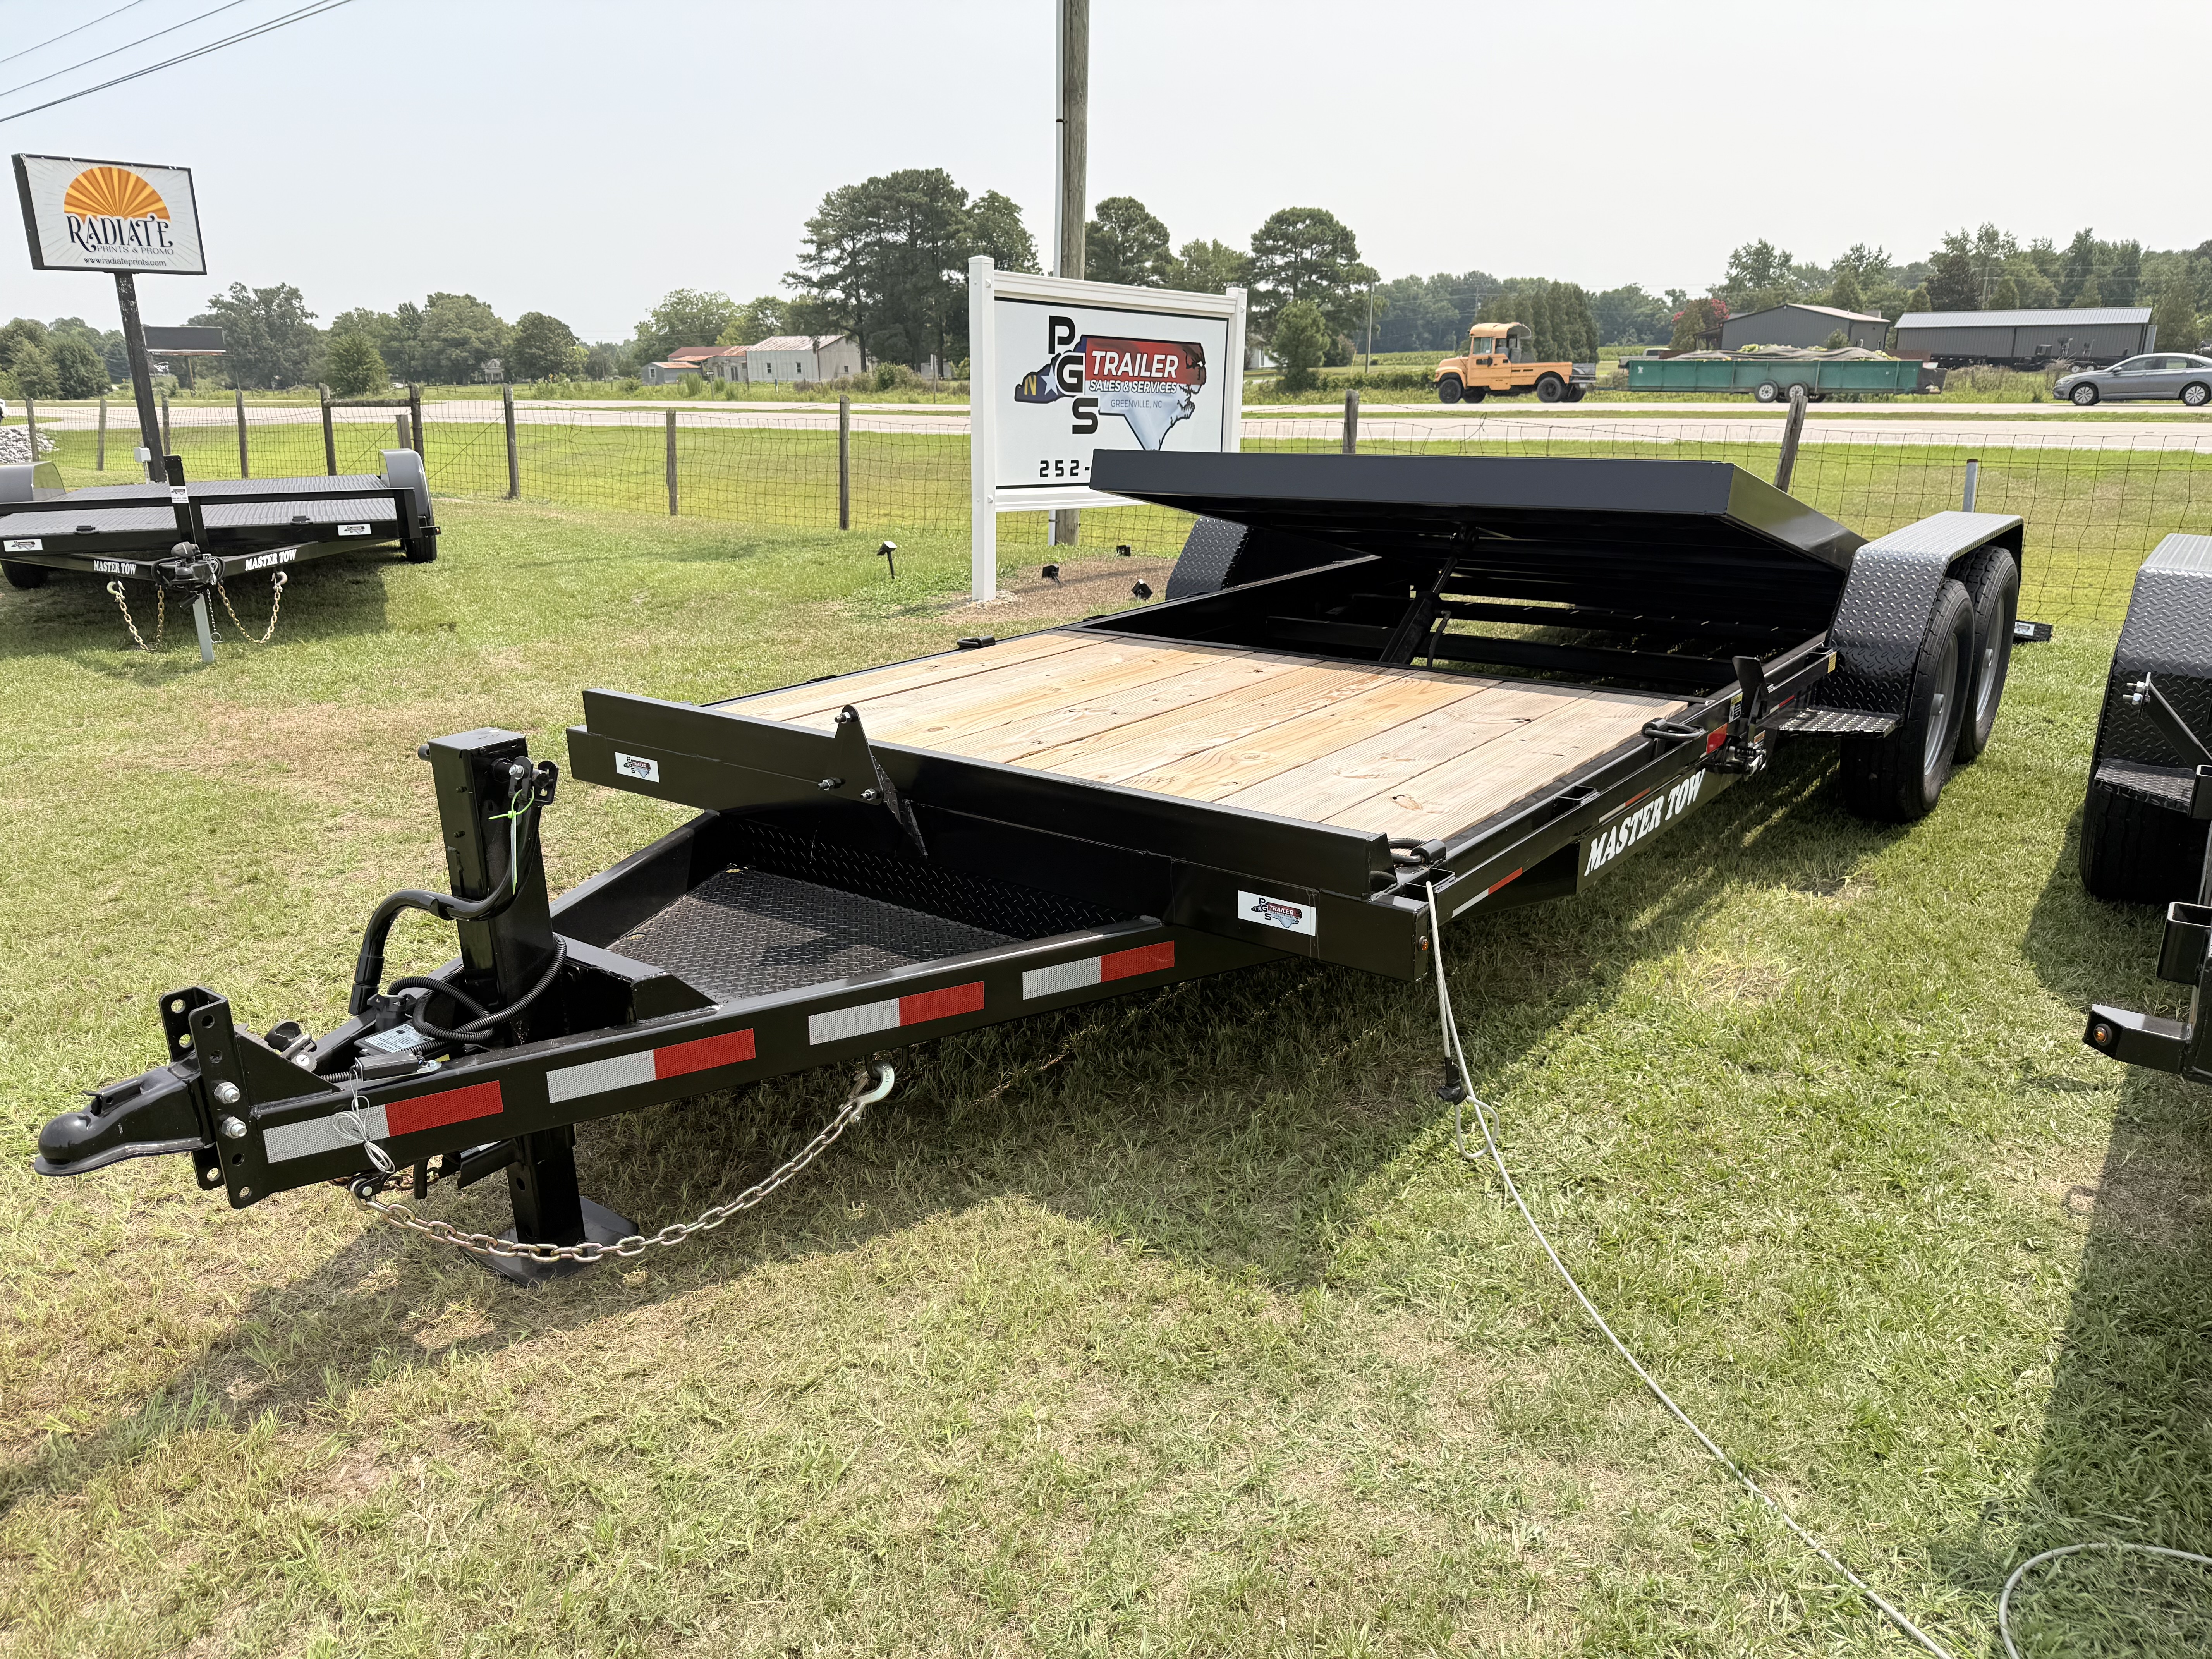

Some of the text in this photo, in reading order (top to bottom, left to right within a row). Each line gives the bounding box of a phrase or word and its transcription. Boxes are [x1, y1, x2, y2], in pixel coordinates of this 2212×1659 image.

[66, 215, 173, 252] RADIATE
[84, 257, 166, 266] www.radiateprints.com
[1092, 350, 1178, 378] TRAILER
[1090, 379, 1177, 393] SALES & SERVICES
[1111, 399, 1162, 409] GREENVILLE, NC
[94, 560, 136, 575] MASTER TOW
[245, 549, 297, 571] MASTER TOW
[1584, 768, 1705, 876] MASTER TOW
[1270, 905, 1294, 915] TRAILER
